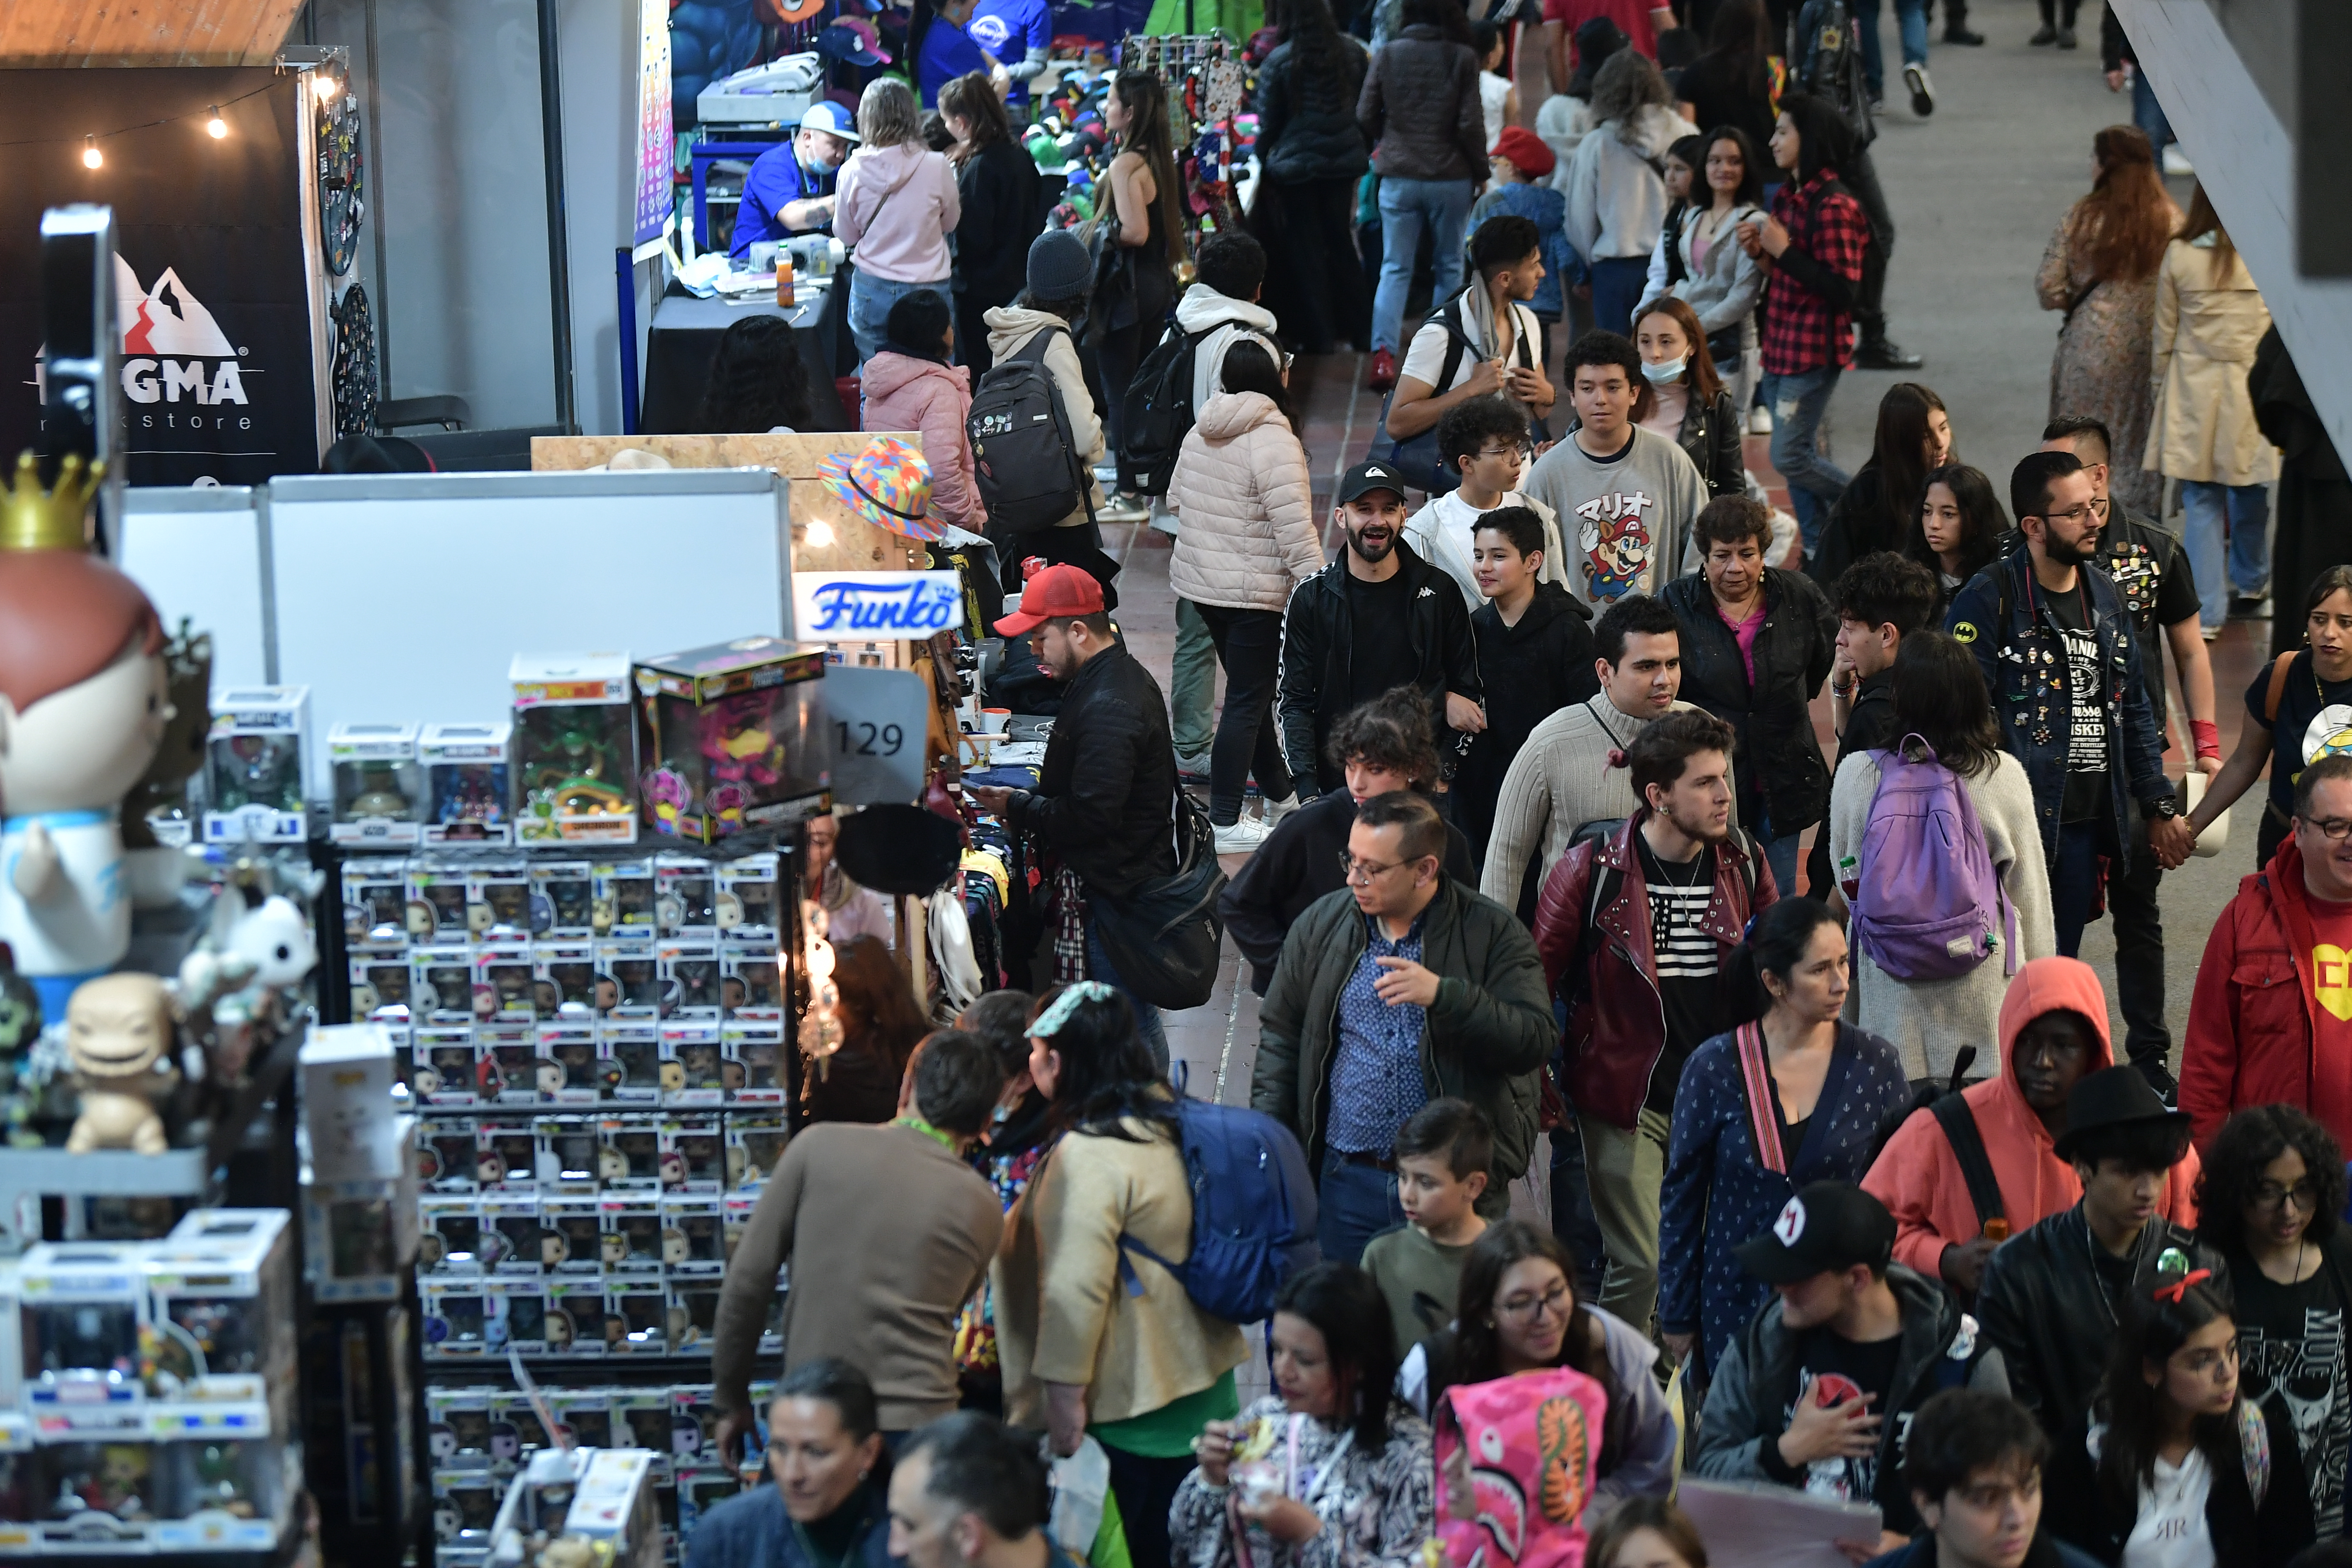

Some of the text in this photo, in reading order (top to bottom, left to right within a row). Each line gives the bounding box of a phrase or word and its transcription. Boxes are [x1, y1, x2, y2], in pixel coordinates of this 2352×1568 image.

[1574, 490, 1652, 522] マリオ
[811, 580, 950, 630] Funko
[835, 721, 903, 756] 129
[2071, 724, 2106, 736] ISKEY
[2318, 961, 2352, 988] C
